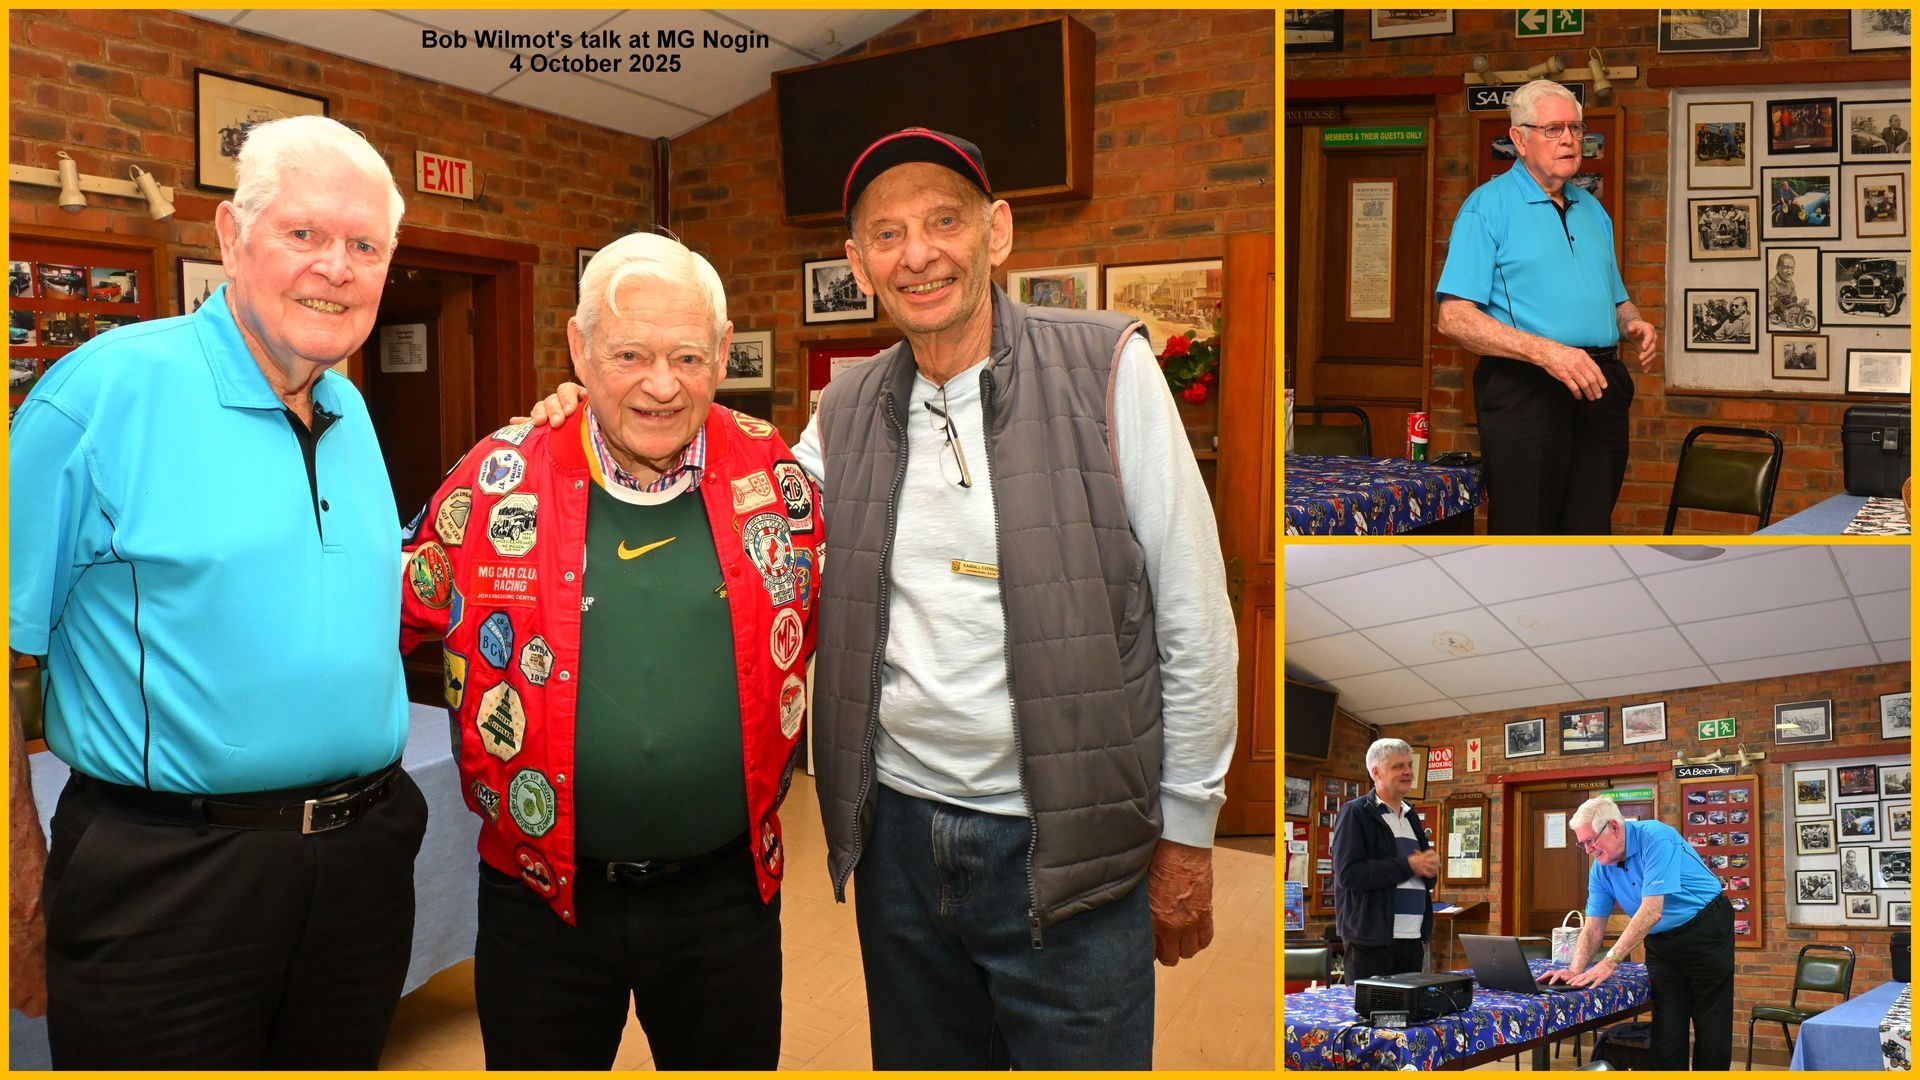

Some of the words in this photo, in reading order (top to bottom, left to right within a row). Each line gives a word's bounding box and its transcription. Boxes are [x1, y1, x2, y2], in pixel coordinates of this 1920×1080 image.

[1304, 110, 1336, 120] HOUSE
[1324, 133, 1354, 142] MEMBERS
[1354, 133, 1360, 141] &
[1360, 132, 1380, 141] THEIR
[1380, 131, 1405, 140] GUESTS
[1405, 131, 1423, 140] ONLY
[423, 156, 466, 195] EXIT
[478, 566, 495, 577] MG
[496, 567, 515, 579] CAR
[516, 568, 538, 580] CLU
[494, 580, 527, 592] RACING
[776, 618, 800, 659] MG
[1428, 750, 1442, 762] NO
[1428, 761, 1452, 769] SMOKING
[1678, 768, 1692, 777] SA
[1692, 766, 1733, 776] Beemer
